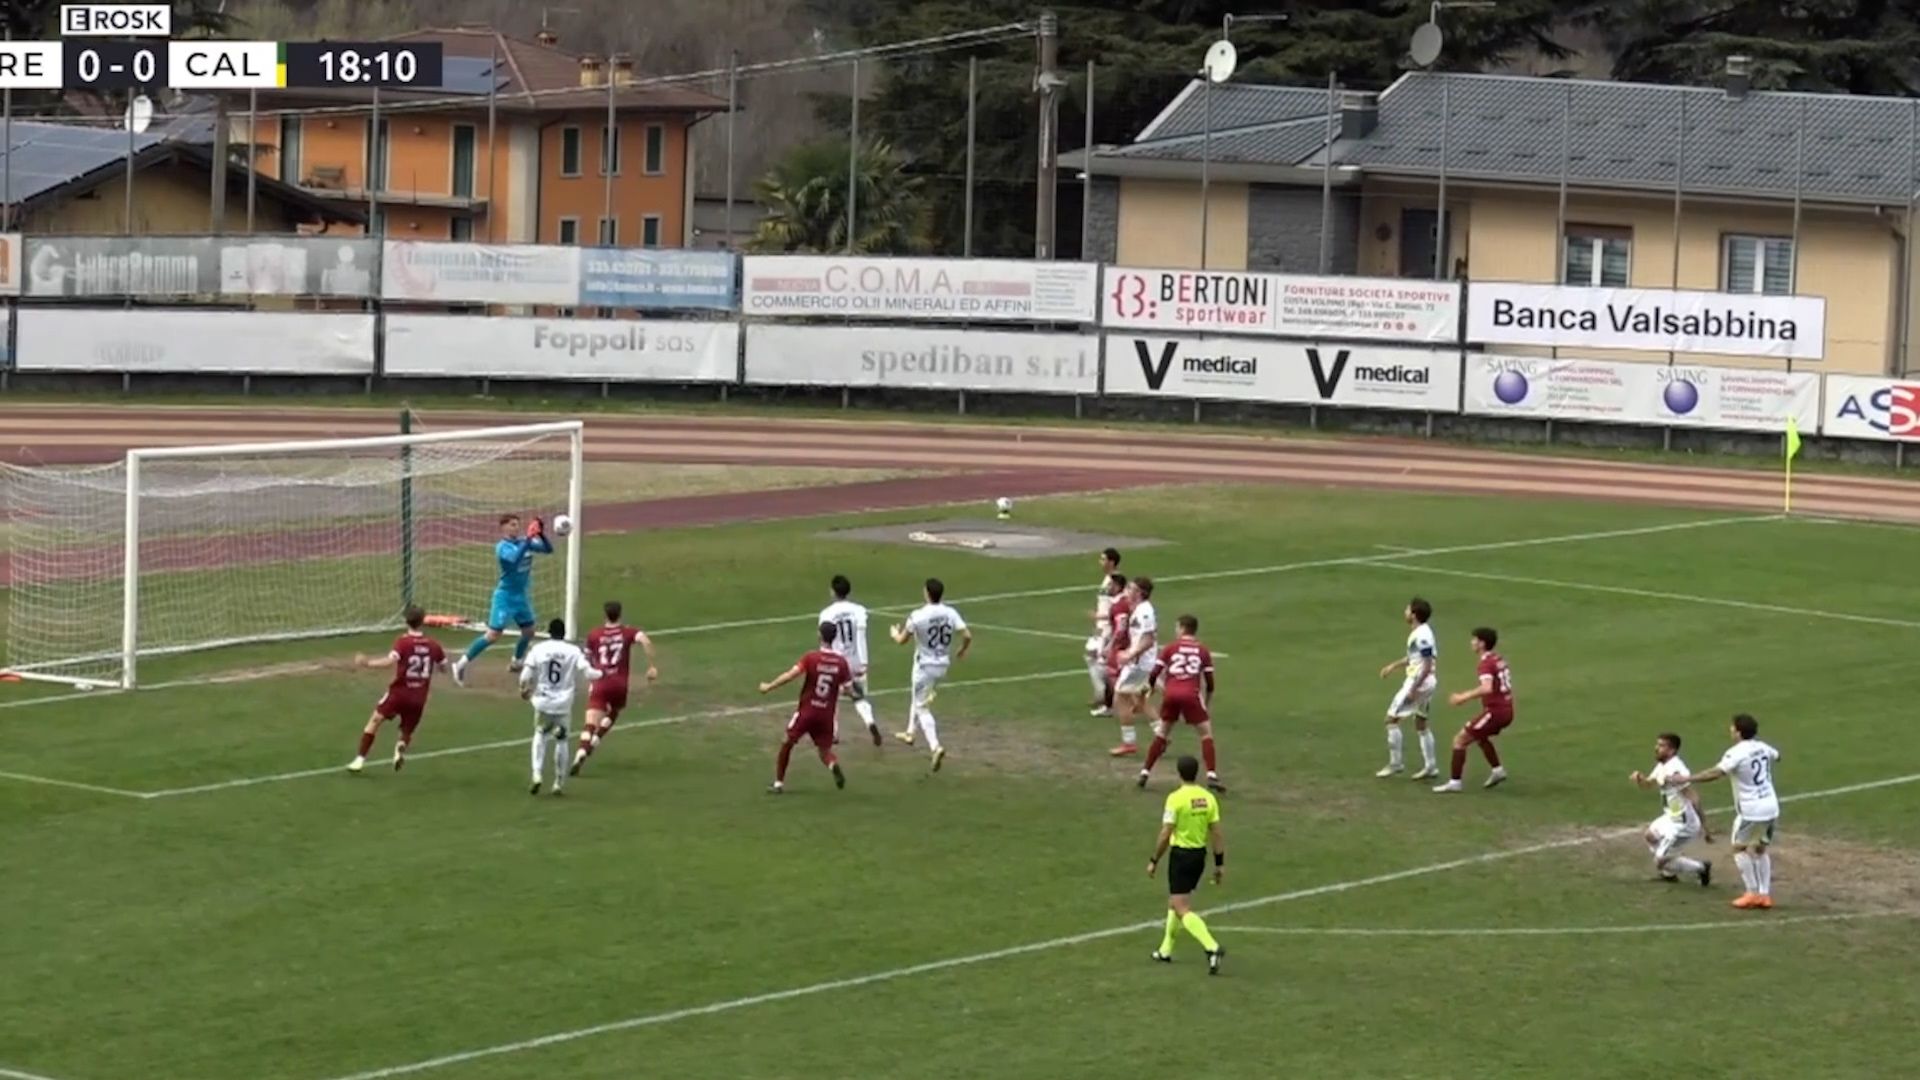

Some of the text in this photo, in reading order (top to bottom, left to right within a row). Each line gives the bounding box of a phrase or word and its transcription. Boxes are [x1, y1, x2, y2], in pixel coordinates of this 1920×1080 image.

[1160, 274, 1268, 307] BERTONI
[1284, 285, 1345, 297] FORNITURE
[1397, 290, 1451, 302] SPORTIVE
[752, 295, 847, 309] COMMERCIO
[885, 297, 955, 310] MINERALI
[960, 298, 980, 311] ED
[985, 299, 1032, 313] AFFINI
[1176, 306, 1267, 326] sportwear
[1493, 299, 1797, 341] Banca Valsabbina
[534, 326, 695, 357] Foppoli sas
[861, 344, 1013, 379] spediban
[1134, 340, 1257, 391] V medical
[1305, 348, 1430, 400] V medical
[1656, 368, 1708, 385] SAVING
[1836, 386, 1920, 434] AS
[927, 624, 952, 649] 26
[406, 656, 431, 678] 21
[599, 643, 623, 666] 17
[1169, 653, 1202, 674] 23
[547, 659, 561, 684] 6
[815, 675, 834, 698] 5
[1751, 756, 1770, 786] 27
